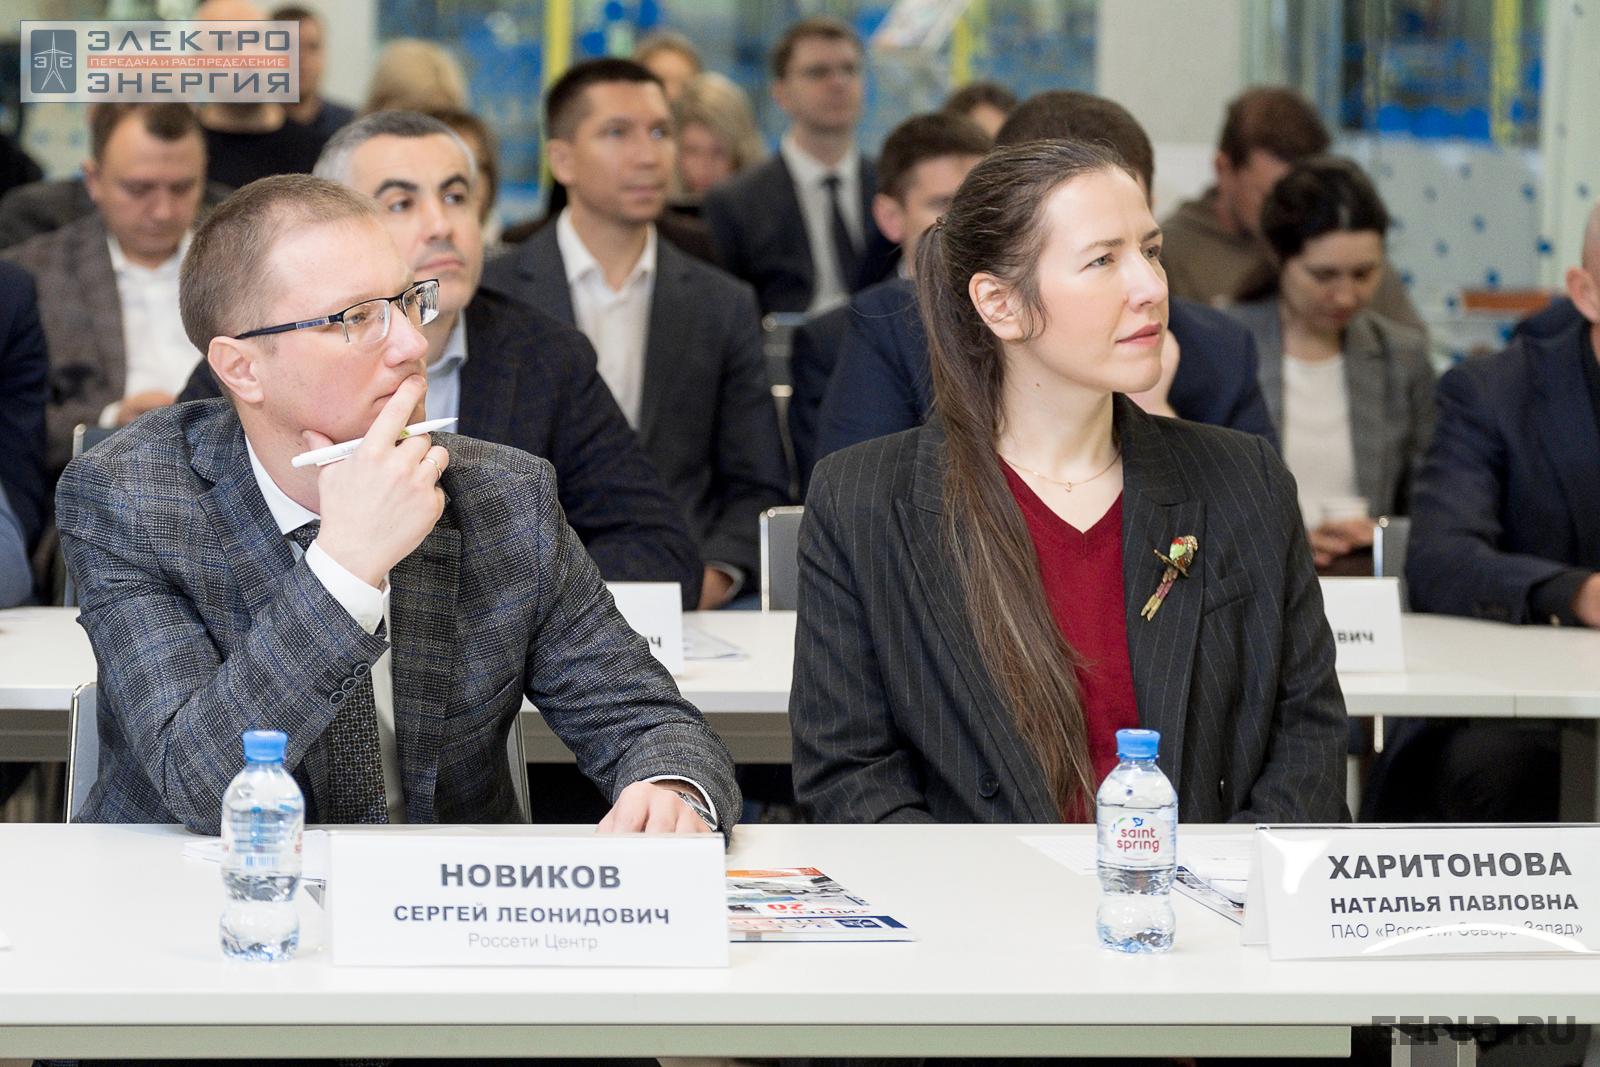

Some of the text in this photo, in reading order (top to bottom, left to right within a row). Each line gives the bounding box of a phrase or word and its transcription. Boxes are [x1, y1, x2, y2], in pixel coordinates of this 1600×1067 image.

[1336, 631, 1375, 643] ВИЧ
[1120, 827, 1156, 839] saint
[1116, 839, 1161, 853] spring
[1327, 852, 1573, 879] ХАРИТОНОВА
[440, 863, 622, 889] НОВИКОВ
[393, 902, 670, 926] СЕРГЕЙ ЛЕОНИДОВИЧ
[1330, 894, 1580, 914] НАТАЛЬЯ ПАВЛОВНА
[1331, 923, 1370, 939] ПАО
[468, 932, 599, 952] Россети Центр
